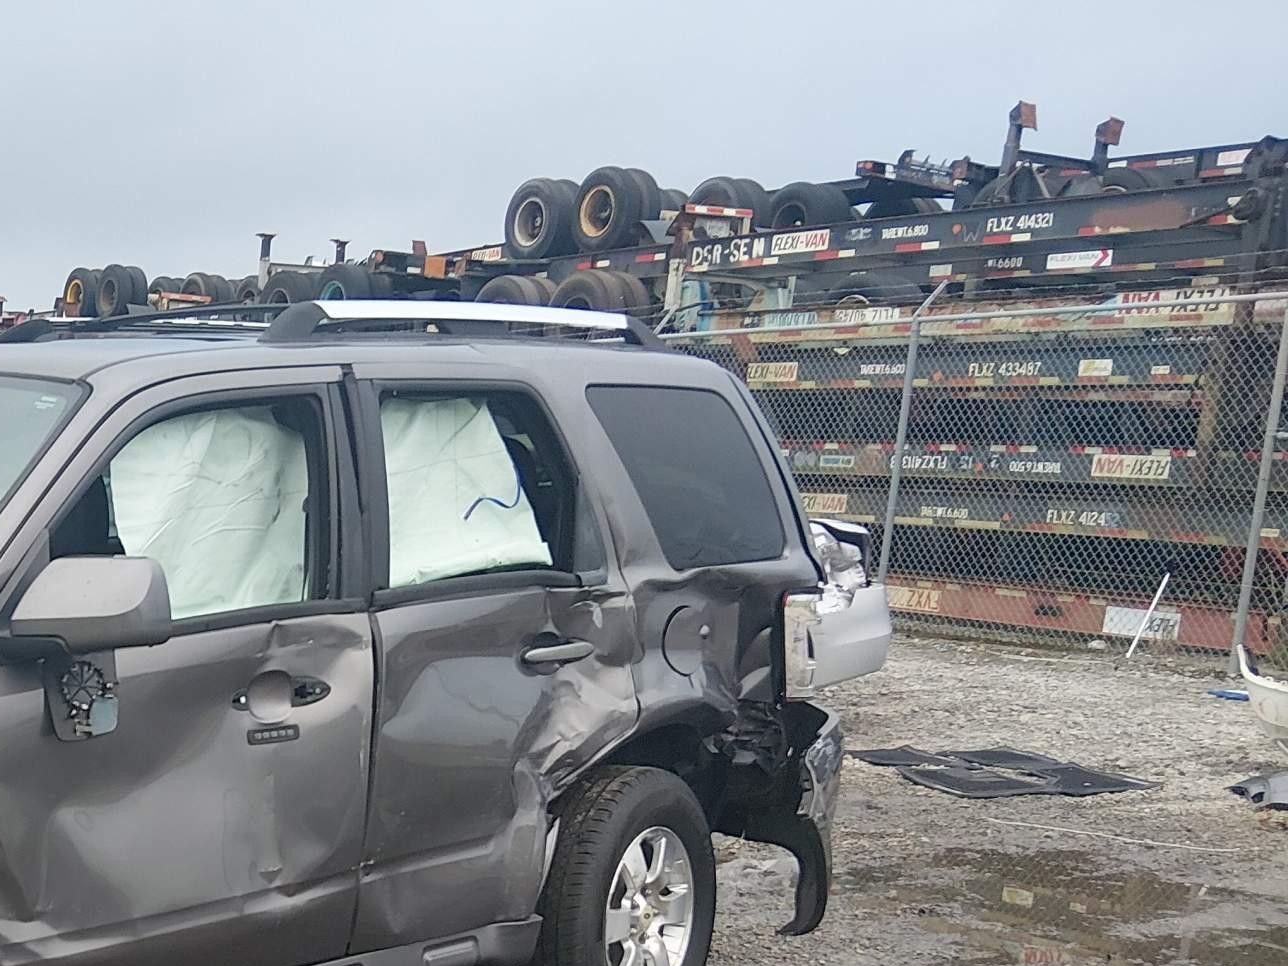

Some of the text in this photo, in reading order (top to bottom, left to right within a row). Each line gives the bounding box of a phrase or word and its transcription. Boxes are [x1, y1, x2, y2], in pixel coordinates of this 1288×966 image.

[986, 212, 1054, 232] FLXZ 414321
[772, 232, 828, 252] FLEXI-VAN
[968, 361, 1041, 376] FLXZ 433487
[1094, 457, 1168, 477] FLEXI-VAN
[1046, 509, 1075, 525] FLXZ
